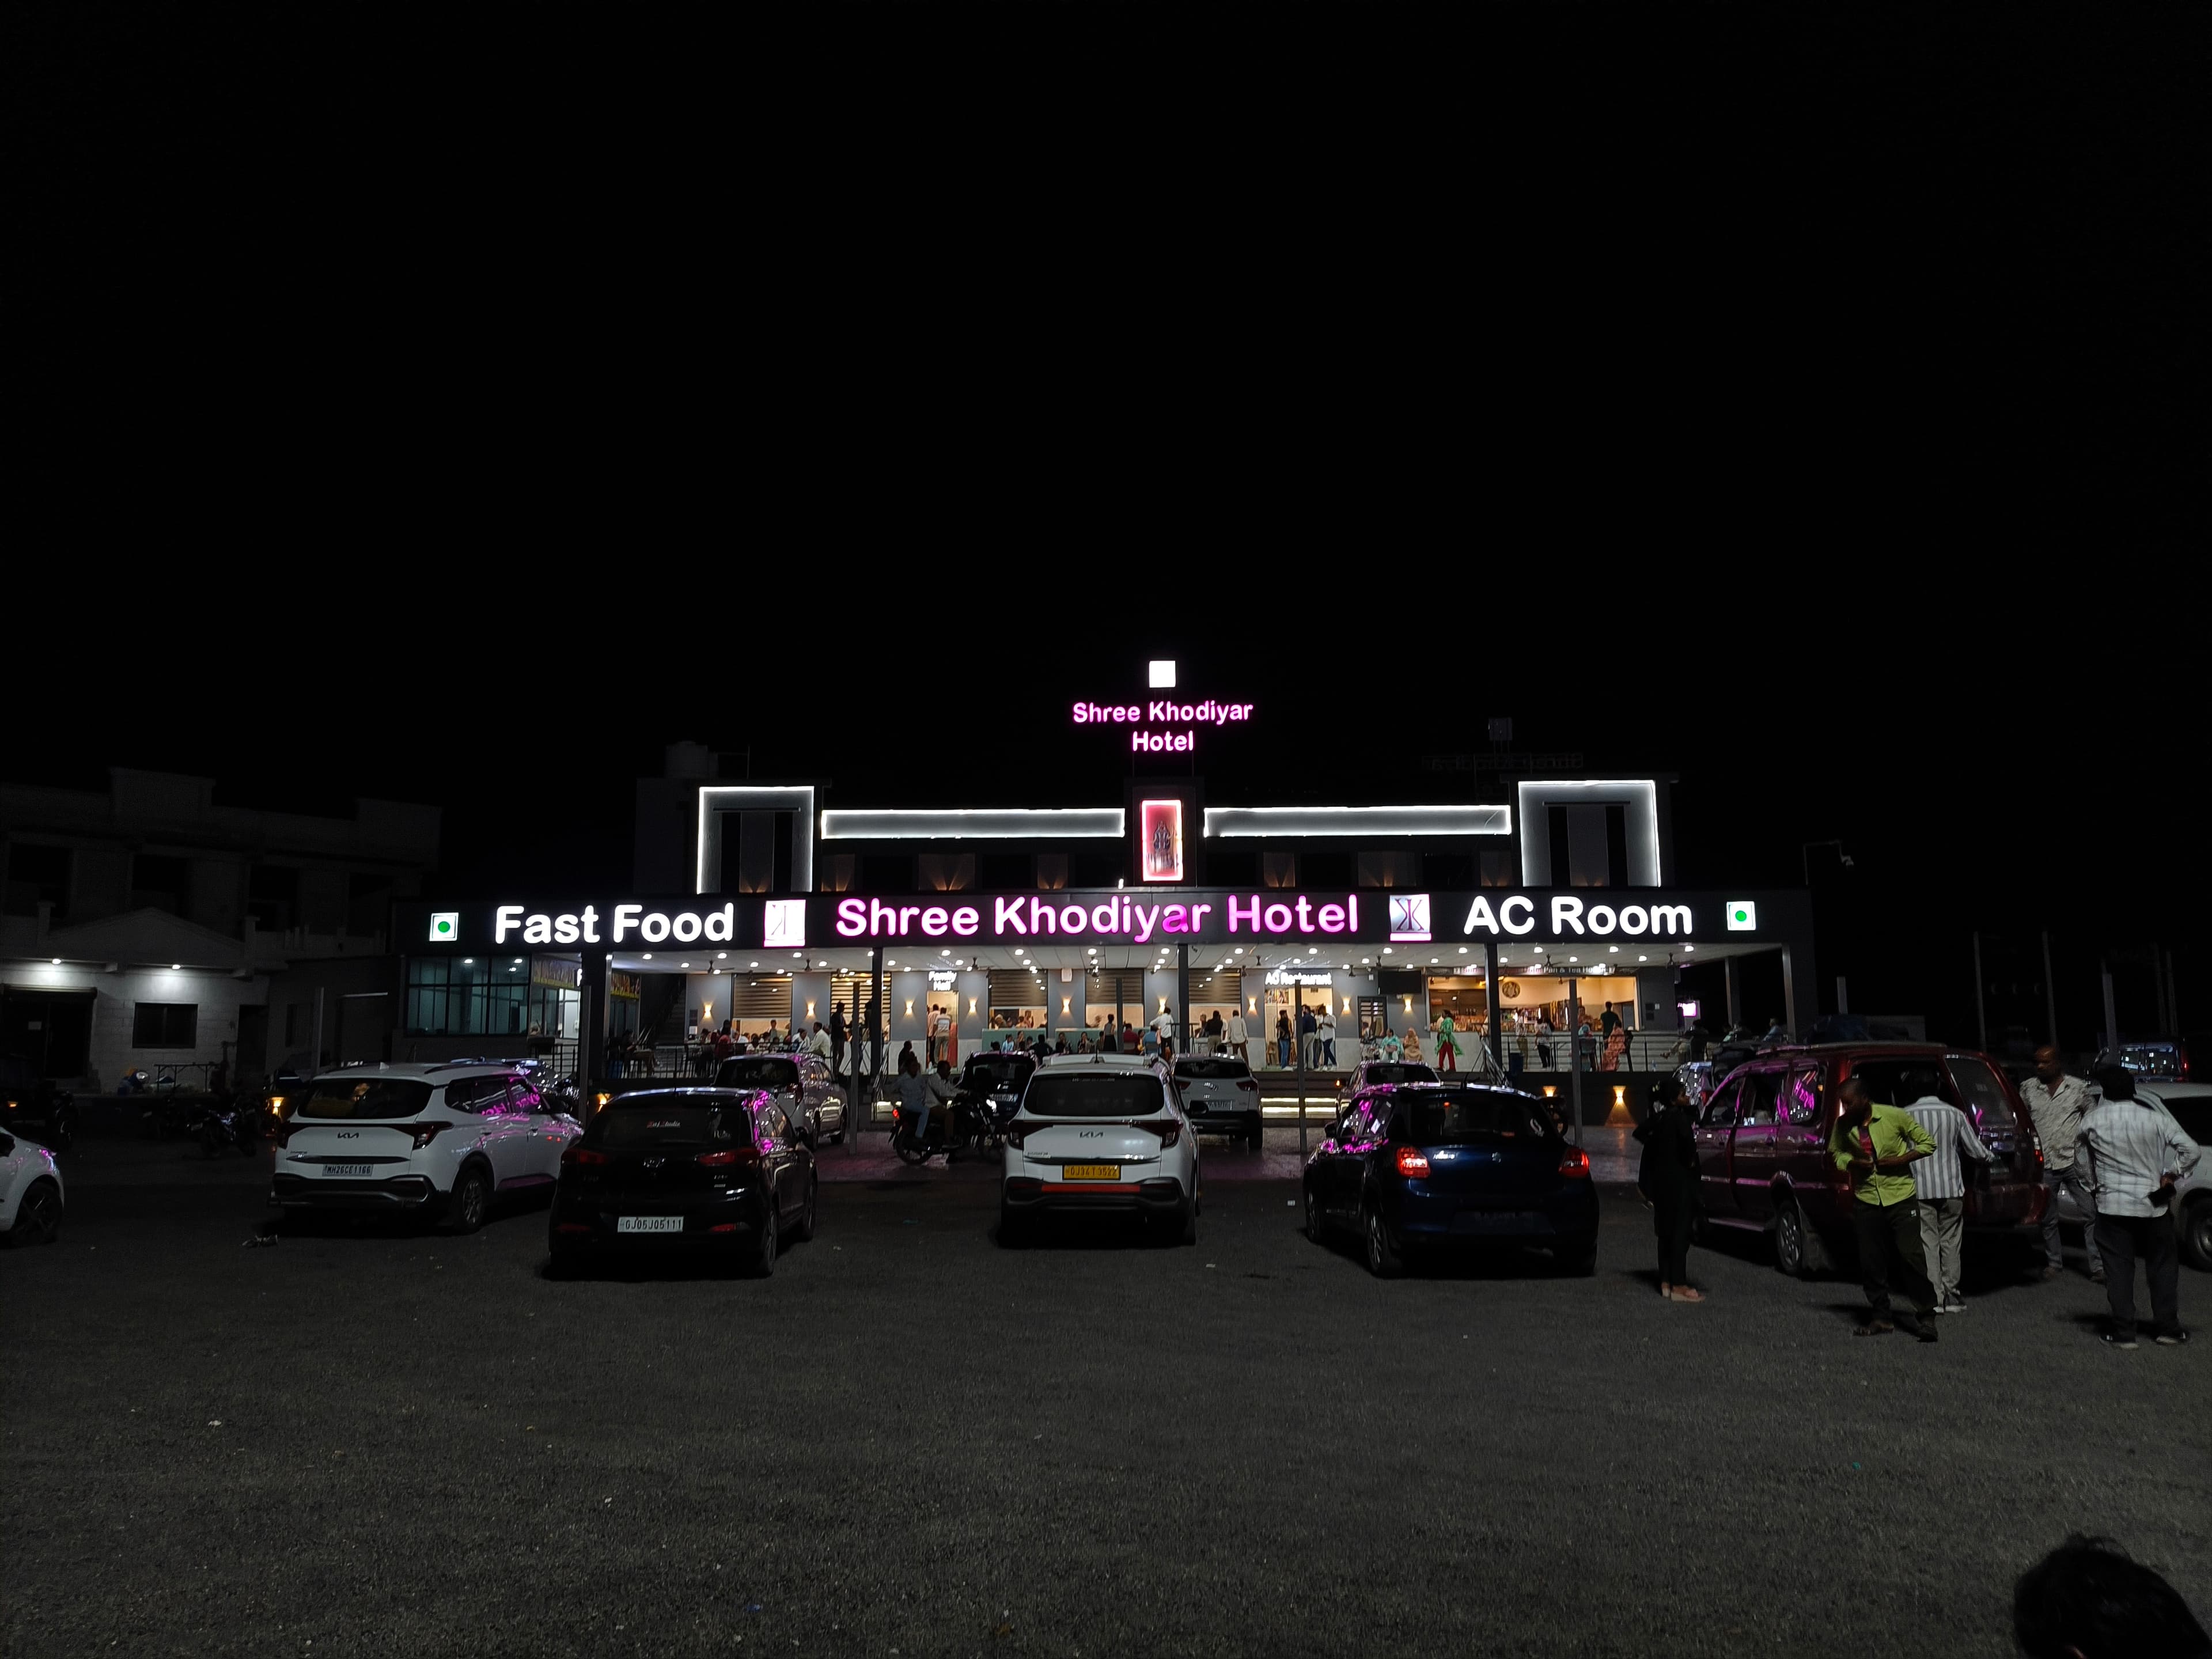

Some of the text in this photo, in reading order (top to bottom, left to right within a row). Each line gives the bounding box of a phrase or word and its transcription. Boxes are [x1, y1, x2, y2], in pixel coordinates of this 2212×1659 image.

[1073, 700, 1254, 725] Shree Khodiyar
[1132, 730, 1194, 752] Hotel
[495, 902, 734, 944] Fast Food
[835, 894, 1358, 944] Shree Khodiyar Hotel
[1463, 895, 1693, 935] AC Room
[928, 971, 957, 983] Family
[1265, 972, 1332, 985] AC Restaurant
